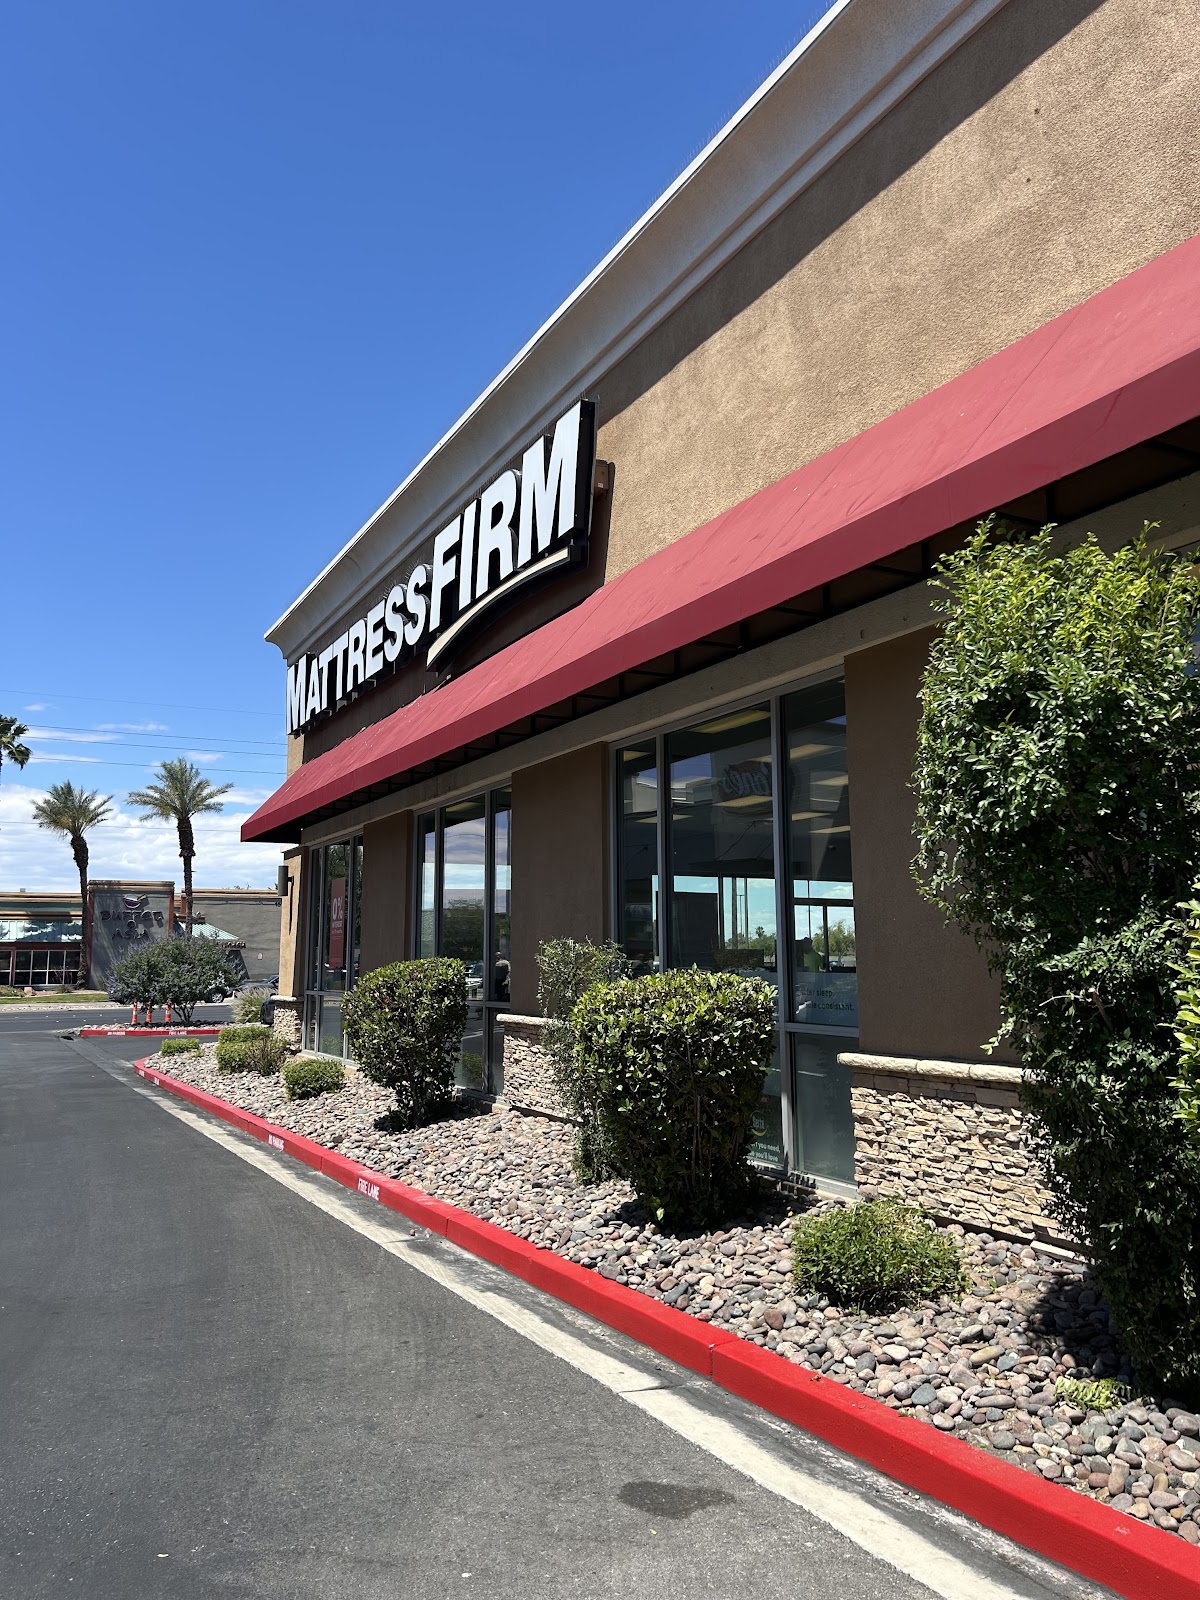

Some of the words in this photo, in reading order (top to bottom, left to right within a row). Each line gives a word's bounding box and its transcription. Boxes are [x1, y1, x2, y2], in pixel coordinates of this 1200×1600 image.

[286, 564, 427, 735] MATTRESS
[429, 400, 582, 632] FIRM
[332, 895, 343, 921] 0%
[758, 1142, 767, 1150] you
[357, 1177, 369, 1195] FIRE
[367, 1182, 380, 1201] LANE
